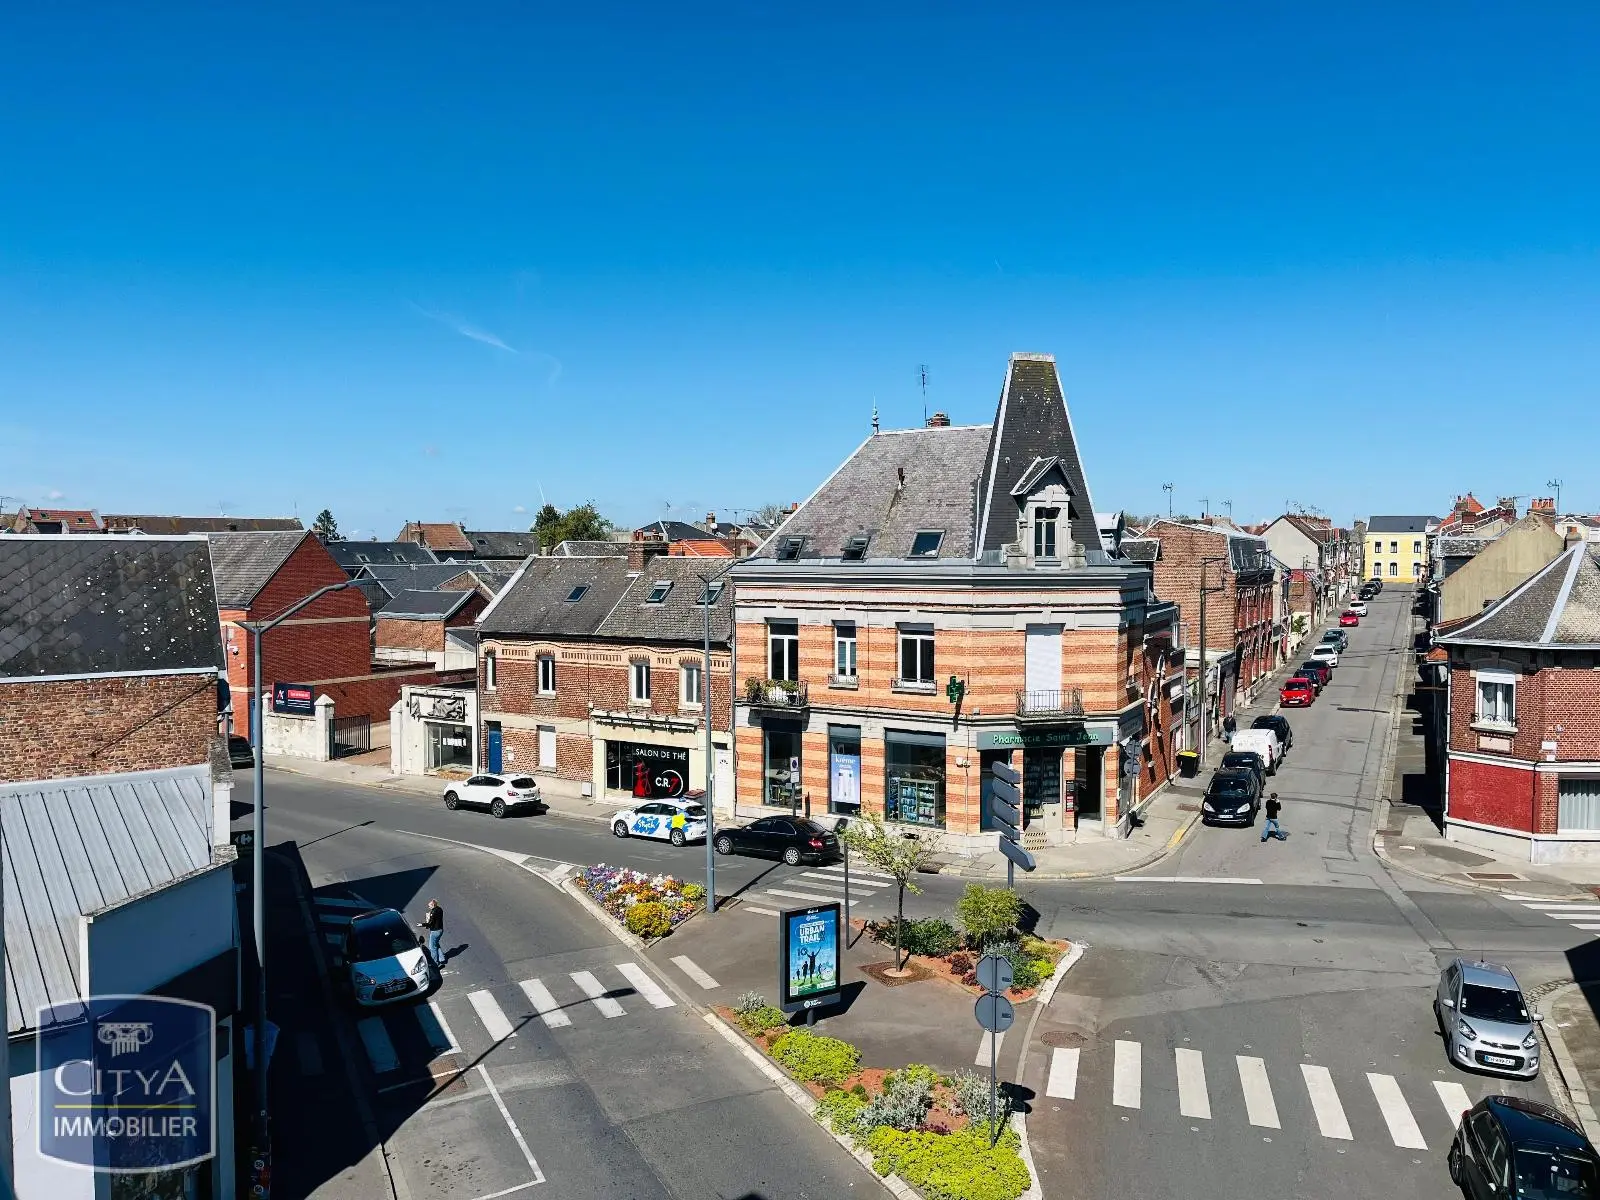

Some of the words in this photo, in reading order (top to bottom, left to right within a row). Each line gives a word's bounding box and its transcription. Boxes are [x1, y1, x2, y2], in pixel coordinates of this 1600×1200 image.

[993, 733, 1040, 744] Pharmacie
[1046, 733, 1070, 742] Saint
[1076, 732, 1099, 741] Jean
[635, 748, 659, 757] SALON
[660, 751, 670, 759] DE
[672, 751, 686, 760] THÉ
[800, 924, 825, 936] URBAN
[800, 932, 820, 944] TRAIL
